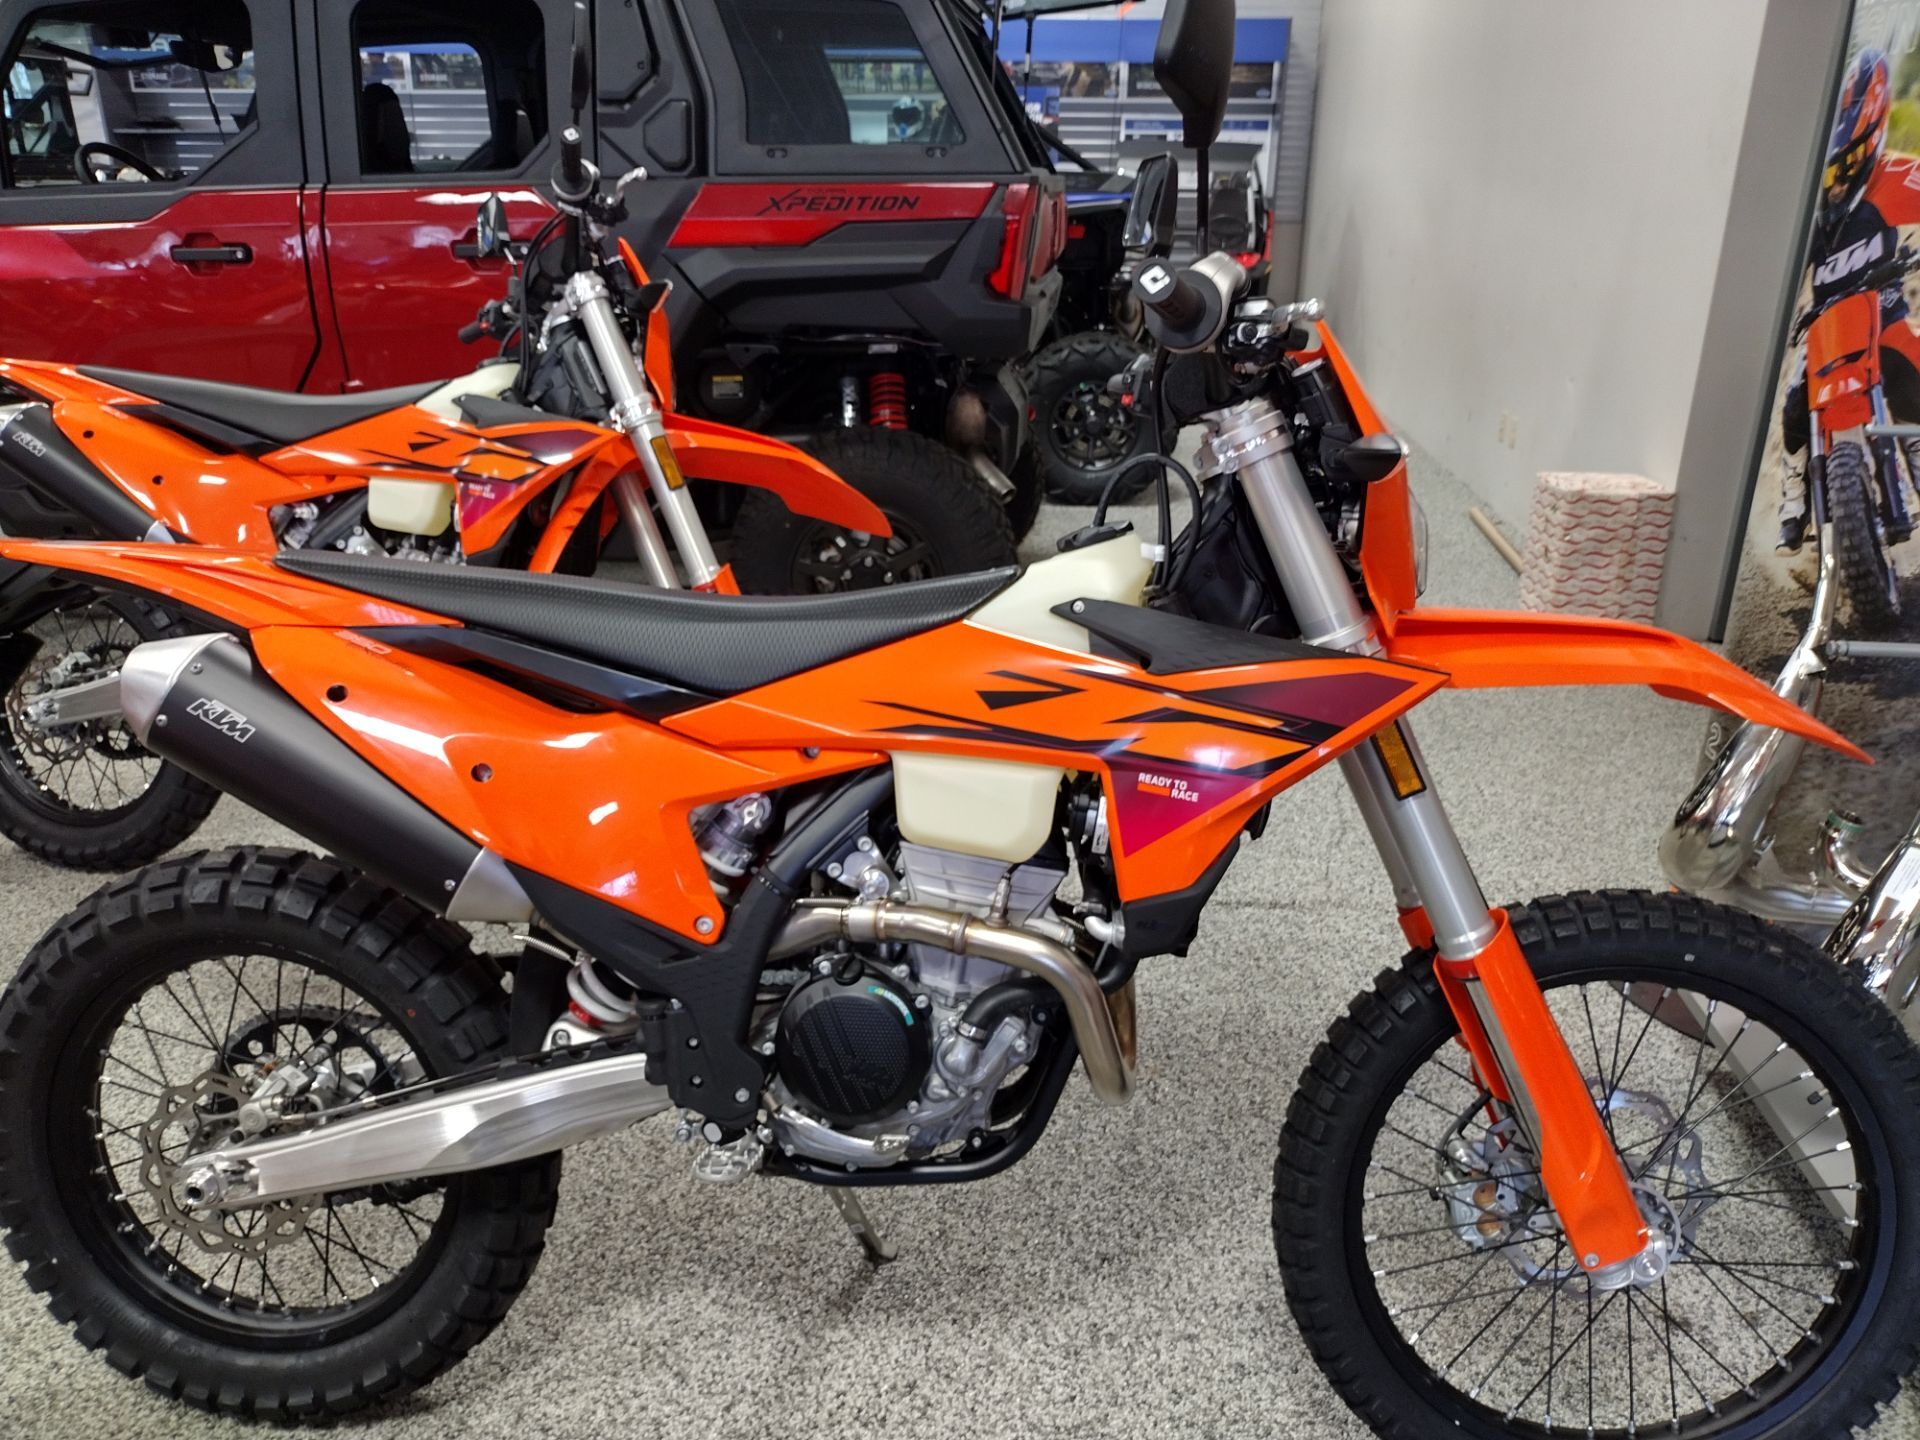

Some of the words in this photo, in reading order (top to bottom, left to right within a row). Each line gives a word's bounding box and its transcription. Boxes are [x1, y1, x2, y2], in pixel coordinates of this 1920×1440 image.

[756, 188, 921, 217] XPEDITION
[1814, 232, 1884, 286] KTM
[12, 431, 47, 457] KTM
[186, 697, 257, 743] KTM
[1138, 772, 1173, 788] READY
[1173, 779, 1188, 791] TO
[1170, 788, 1199, 803] RACE
